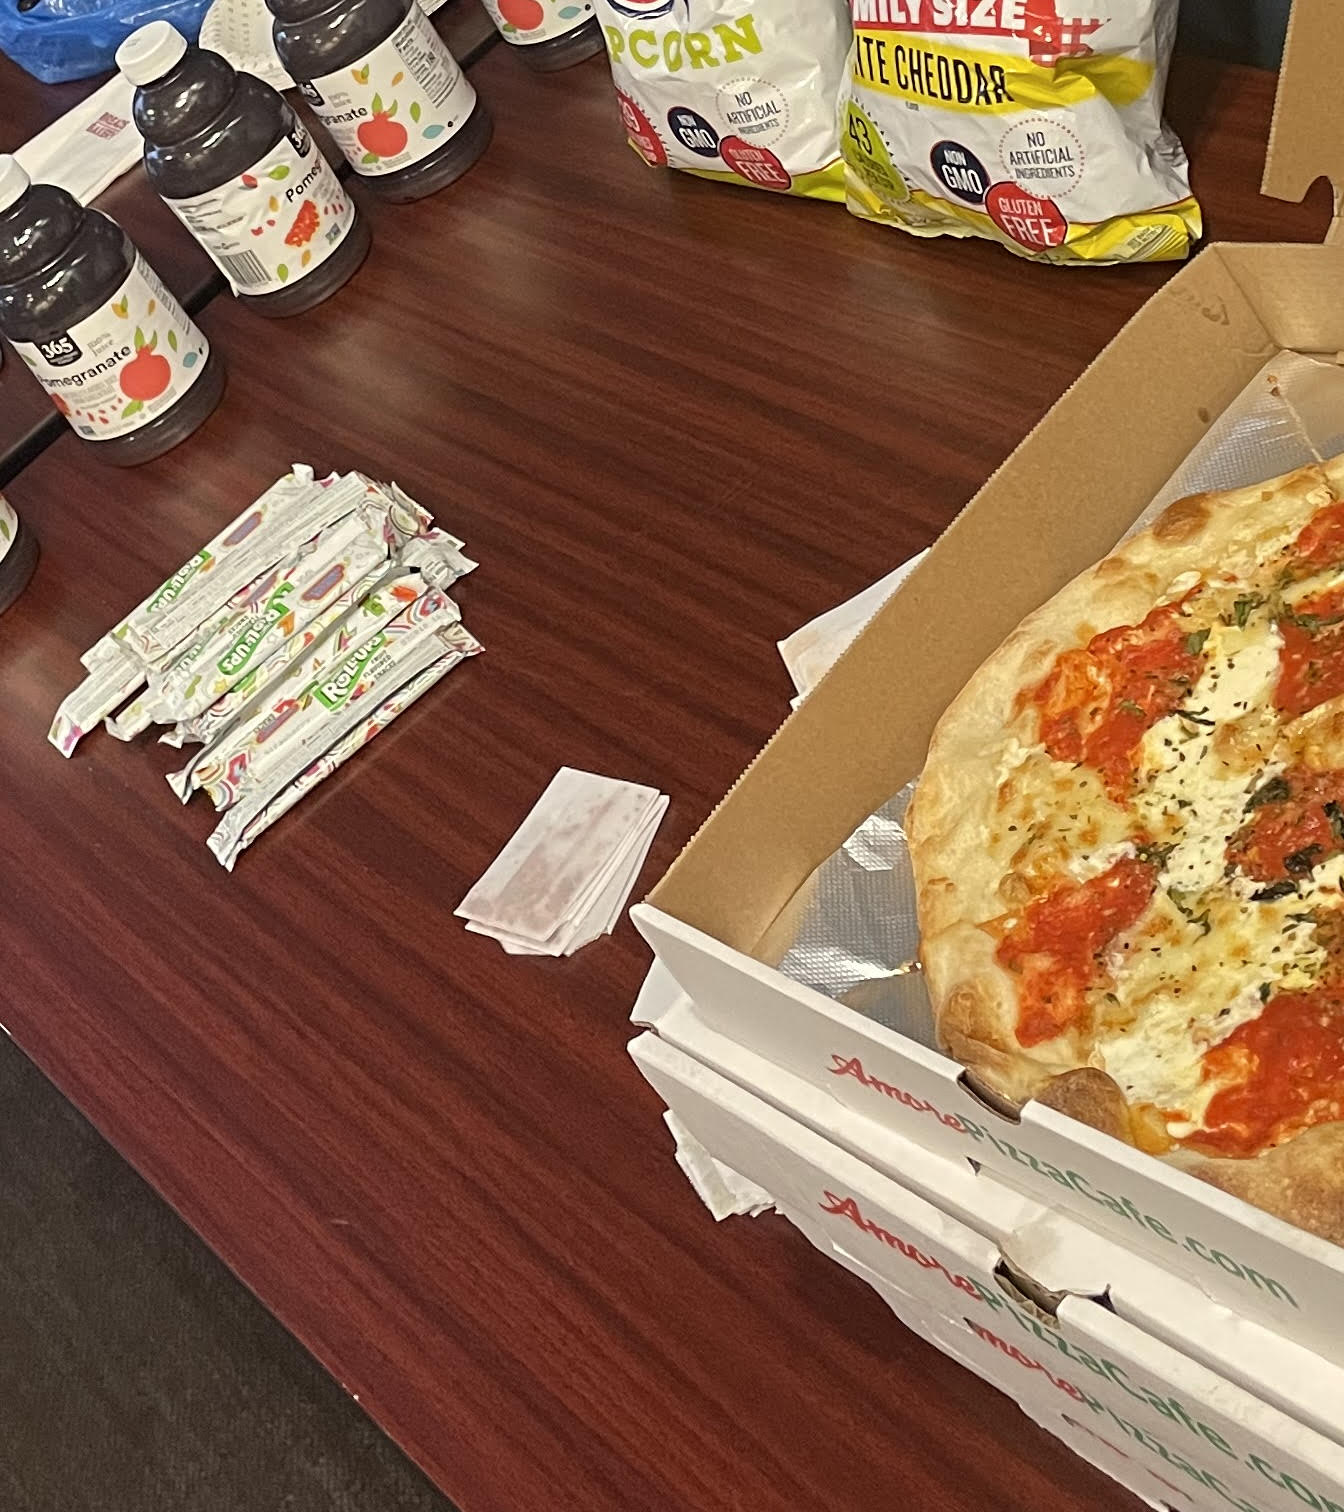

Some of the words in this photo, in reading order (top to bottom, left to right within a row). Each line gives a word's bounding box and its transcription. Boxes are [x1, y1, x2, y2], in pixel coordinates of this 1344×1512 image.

[894, 44, 1015, 106] CHEDDAR
[735, 91, 752, 107] NO
[678, 128, 717, 150] GMO
[1027, 131, 1046, 148] NO
[1009, 146, 1075, 167] ARTIFICIAL
[737, 162, 788, 183] FREE
[941, 165, 984, 195] GMO
[998, 197, 1044, 217] GLUTEN
[1005, 217, 1059, 247] FREE
[40, 337, 74, 360] 365
